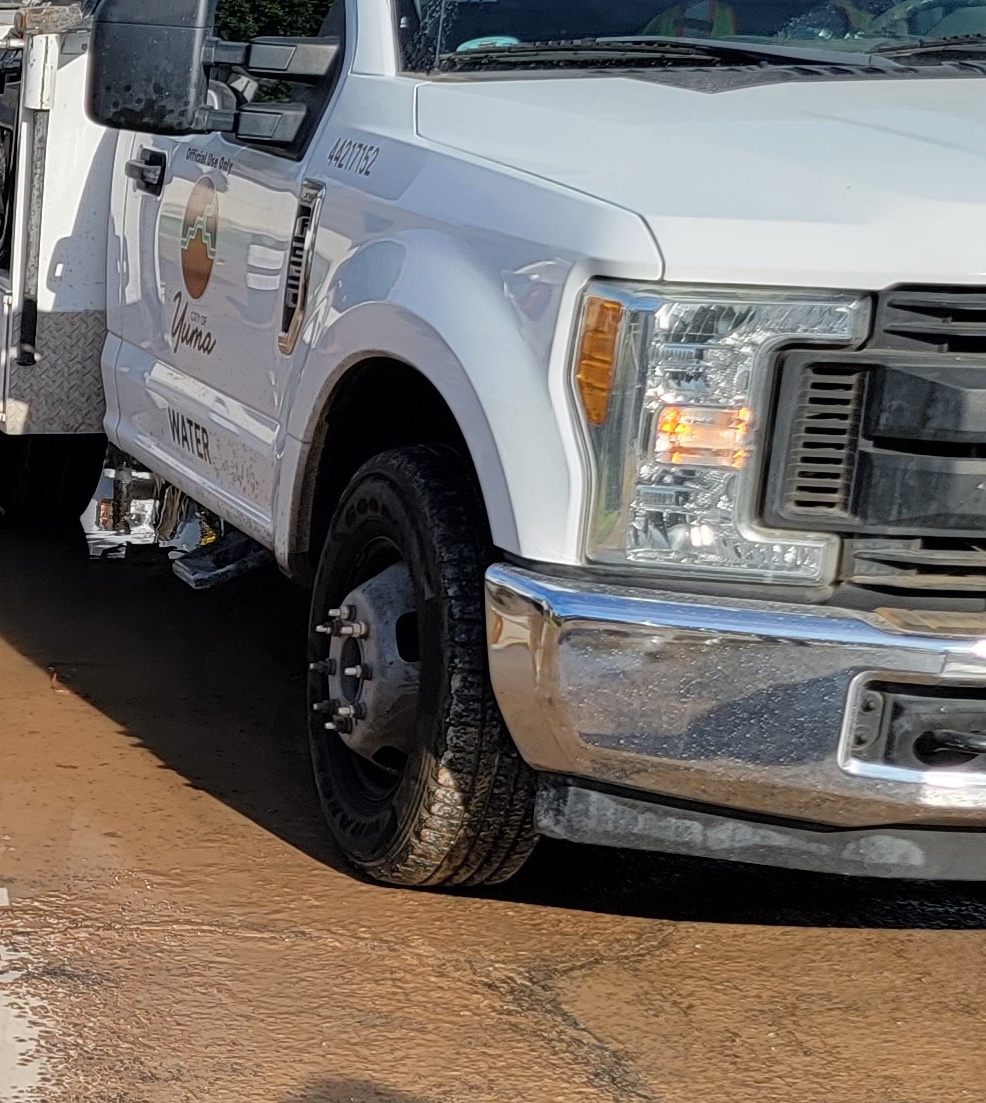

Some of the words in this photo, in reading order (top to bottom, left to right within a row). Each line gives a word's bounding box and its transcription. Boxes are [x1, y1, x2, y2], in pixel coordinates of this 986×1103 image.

[185, 146, 208, 165] Official
[206, 152, 219, 169] Use
[218, 156, 234, 176] Only
[328, 137, 380, 177] 44217152
[170, 290, 217, 356] Yuma
[190, 311, 201, 324] CITY
[200, 314, 208, 327] OF
[167, 406, 212, 466] WATER
